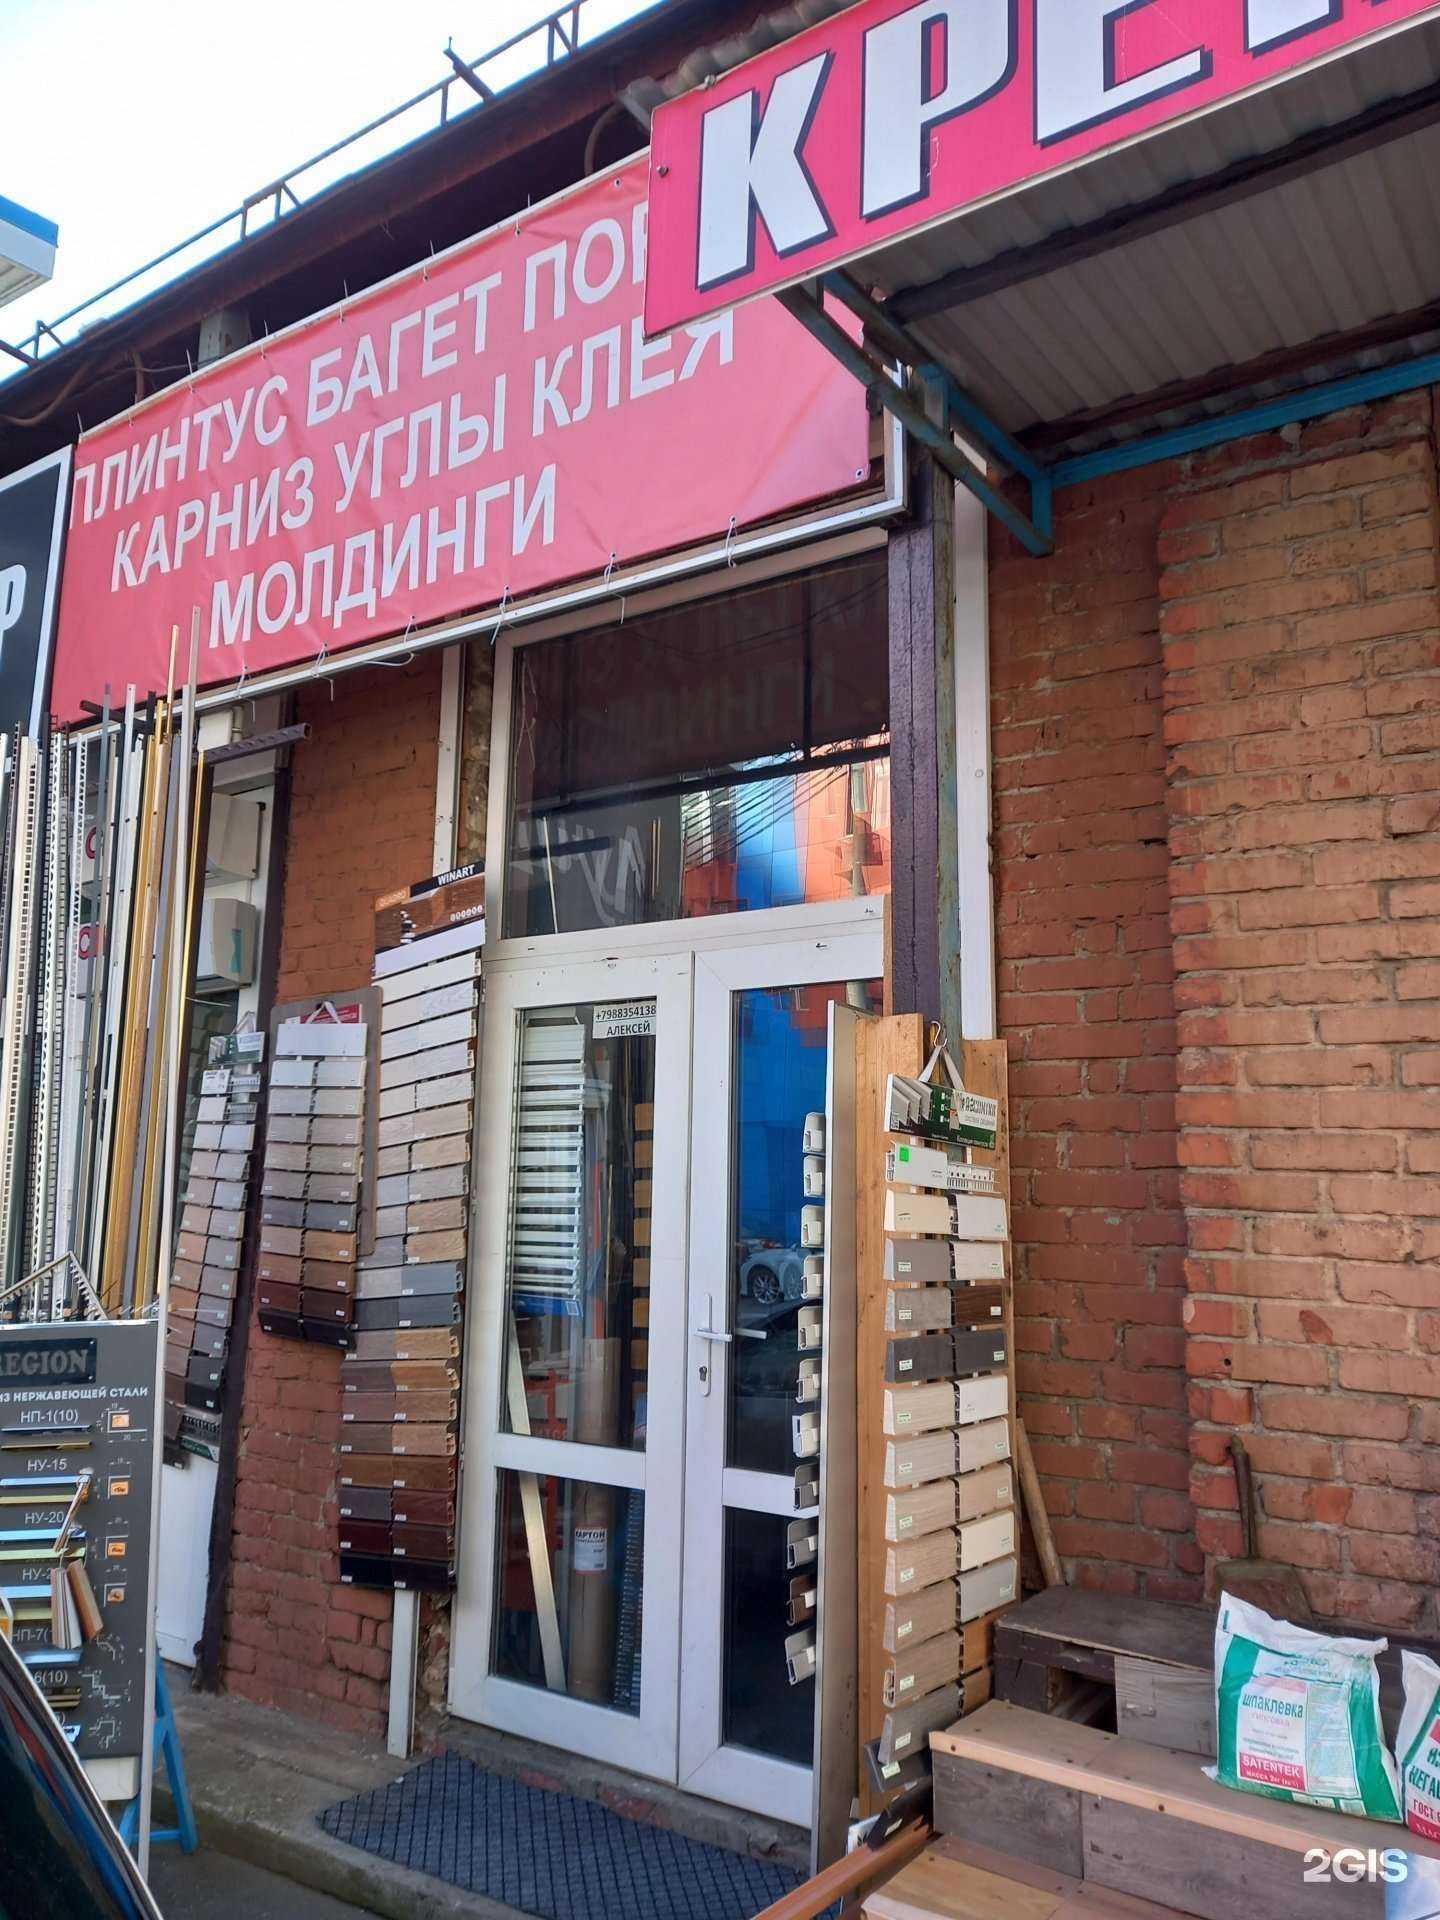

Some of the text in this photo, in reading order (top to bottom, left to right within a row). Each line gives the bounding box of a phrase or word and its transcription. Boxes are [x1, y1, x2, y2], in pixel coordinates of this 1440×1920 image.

[696, 0, 1388, 292] КРЕ
[69, 374, 289, 531] ПЛИНТУС
[304, 270, 502, 428] БАГЕТ
[110, 308, 734, 594] КАРНИЗ УГЛЫ КЛЕЯ
[207, 463, 558, 649] МОЛДИНГИ
[438, 864, 475, 885] WINART
[607, 1020, 651, 1036] АЛЕКСЕЙ
[0, 1349, 89, 1377] EGION
[13, 1386, 107, 1403] НЕРЖАВЕЮЩЕЙ
[110, 1386, 148, 1398] СТАЛИ
[20, 1408, 79, 1424] НП-1(10)
[27, 1458, 67, 1472] НУ-15
[25, 1511, 64, 1524] НУ-20
